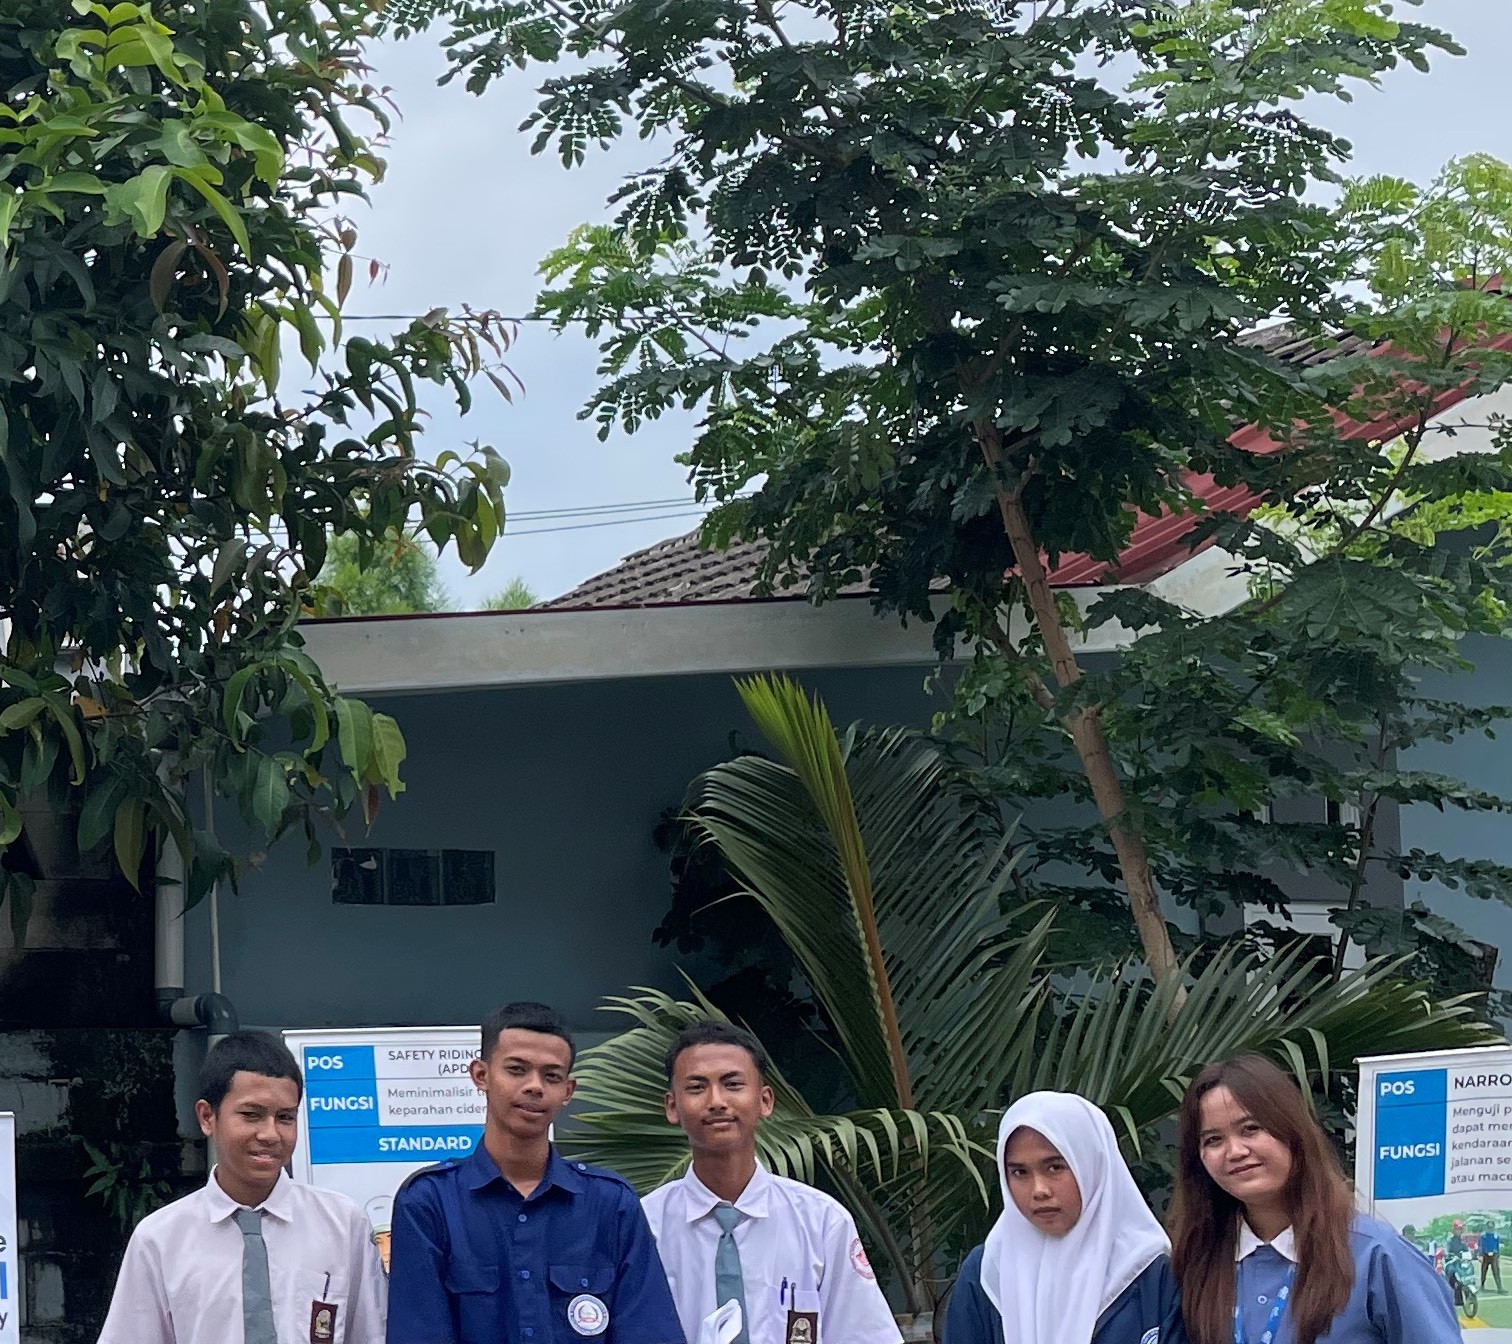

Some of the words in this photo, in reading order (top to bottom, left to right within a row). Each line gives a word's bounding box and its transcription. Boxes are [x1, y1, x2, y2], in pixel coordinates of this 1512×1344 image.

[388, 1050, 435, 1060] SAFETY
[308, 1056, 343, 1070] POS
[438, 1064, 469, 1076] (APD
[388, 1086, 473, 1098] Meminimalisir
[1380, 1080, 1415, 1097] POS
[1454, 1074, 1512, 1089] NARRO
[310, 1096, 373, 1111] FUNGSI
[389, 1104, 453, 1117] keparahan
[1453, 1104, 1500, 1117] Menguji
[1452, 1122, 1484, 1134] dapat
[378, 1136, 472, 1151] STANDARD
[1379, 1143, 1440, 1160] FUNGSI
[1450, 1156, 1493, 1170] jalanan
[1451, 1174, 1475, 1184] atau
